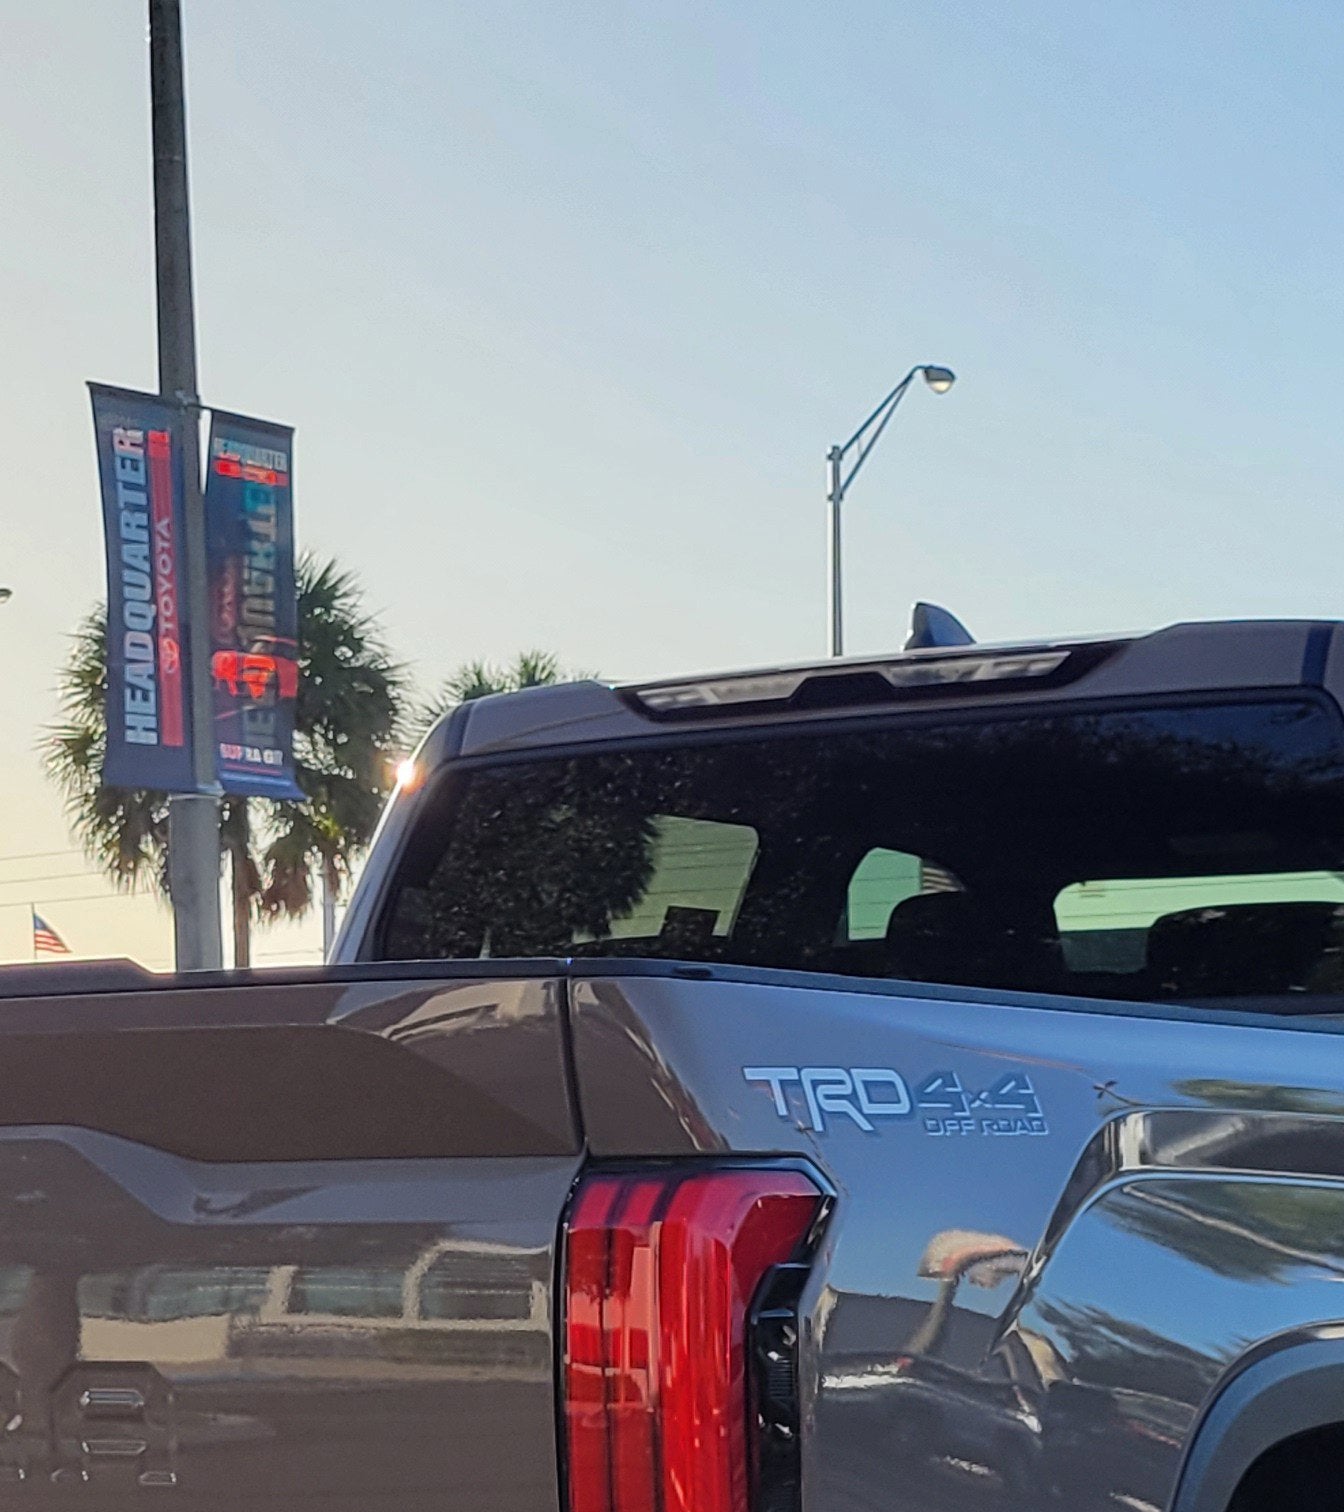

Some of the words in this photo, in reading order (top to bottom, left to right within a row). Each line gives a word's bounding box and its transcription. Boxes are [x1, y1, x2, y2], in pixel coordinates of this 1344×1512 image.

[113, 427, 158, 746] HEADQUARTER
[157, 518, 174, 635] TOYOTA
[743, 1066, 911, 1132] TRD
[925, 1118, 975, 1136] OFF
[980, 1119, 1049, 1136] ROAD
